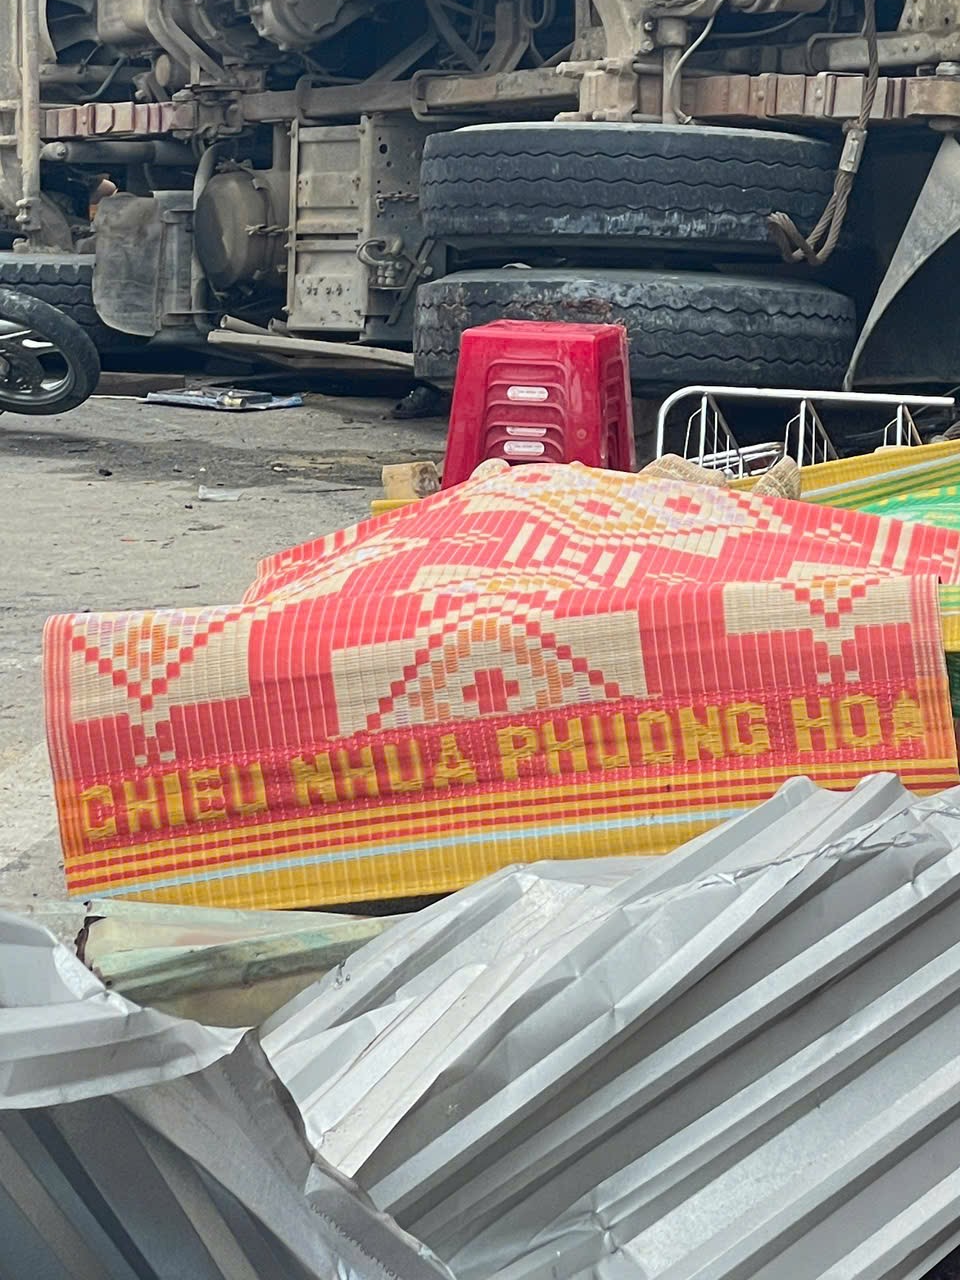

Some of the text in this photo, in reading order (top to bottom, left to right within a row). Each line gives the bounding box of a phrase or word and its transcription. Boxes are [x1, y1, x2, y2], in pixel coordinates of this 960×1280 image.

[81, 690, 926, 843] CHIEU NHUA PHUONG HOA
